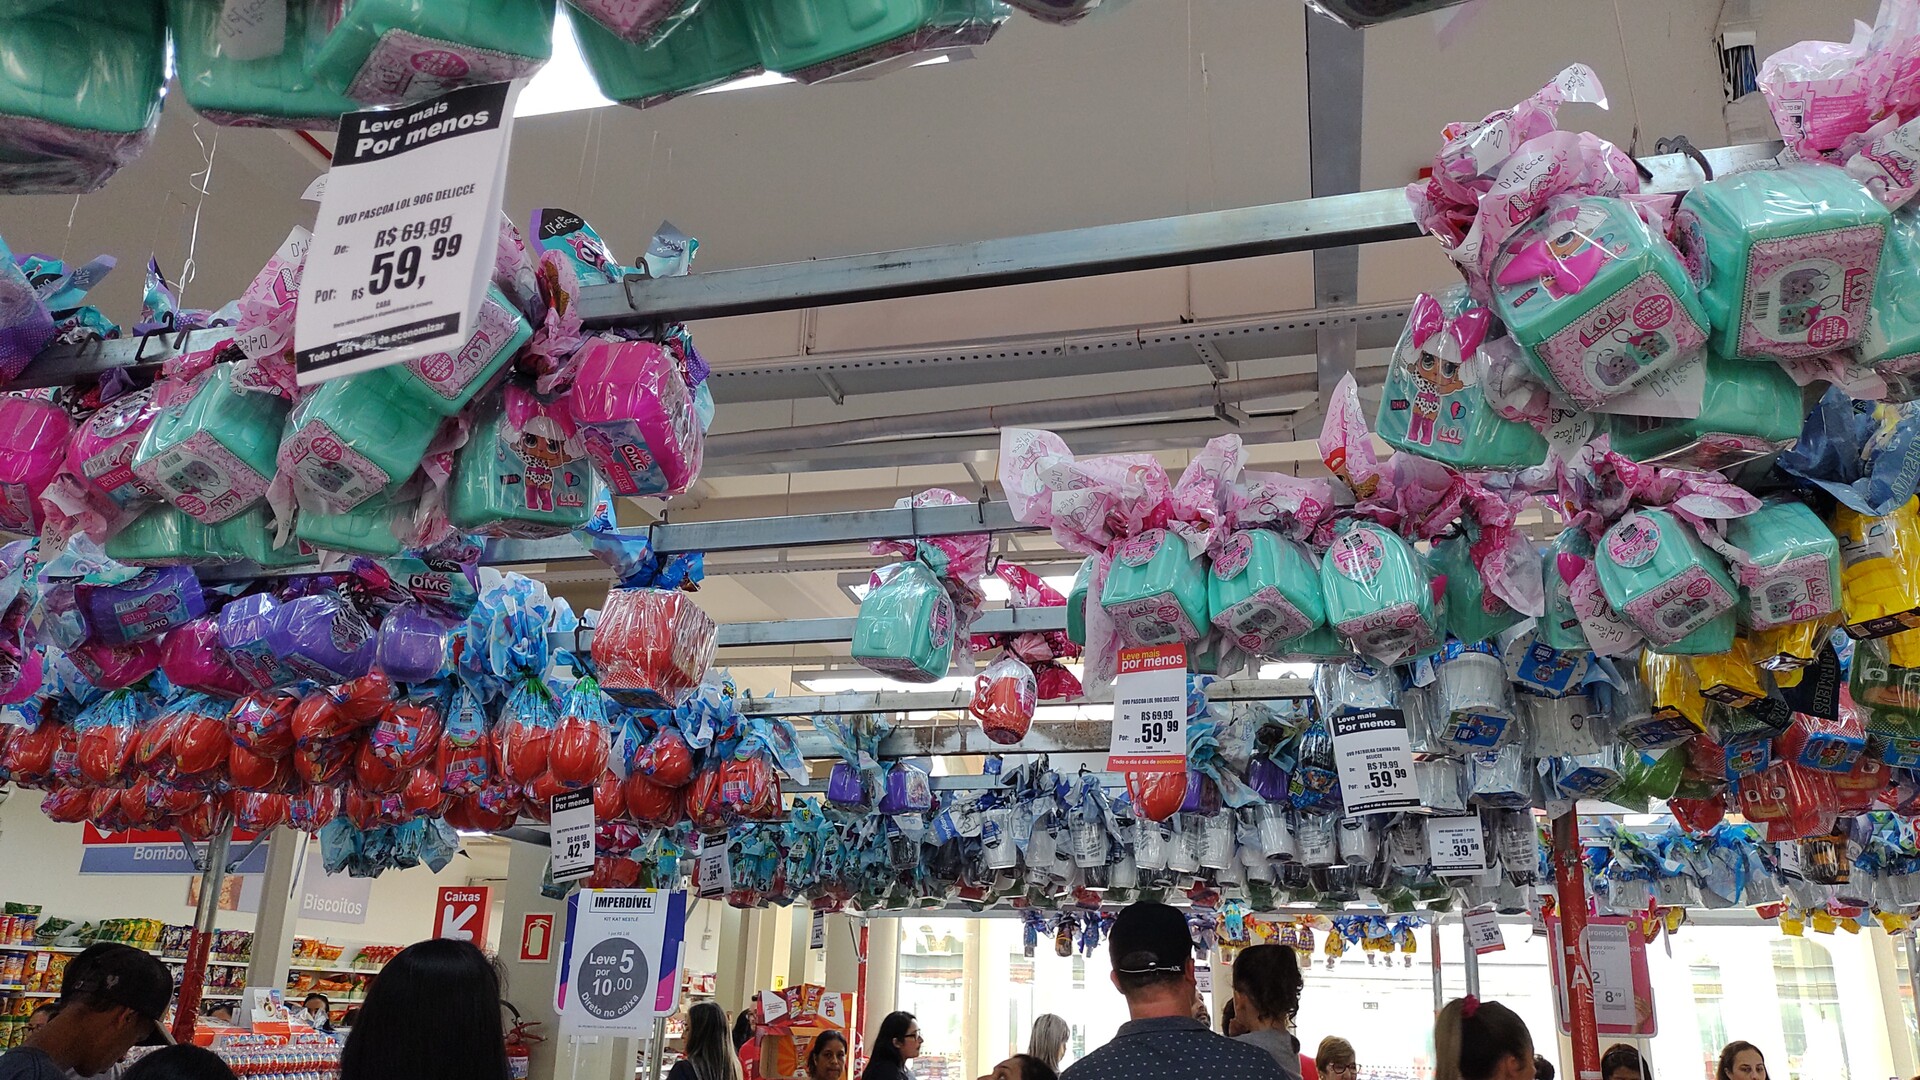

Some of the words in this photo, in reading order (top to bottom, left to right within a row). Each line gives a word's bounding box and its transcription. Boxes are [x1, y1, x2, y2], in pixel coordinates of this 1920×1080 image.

[358, 119, 404, 135] Leve
[408, 101, 449, 125] mais
[354, 134, 401, 158] Por
[405, 110, 489, 146] menos
[1499, 153, 1545, 191] D'elicce
[337, 211, 358, 226] OVO
[358, 203, 394, 222] PASCOA
[396, 197, 411, 212] LOL
[412, 192, 434, 207] 90G
[435, 183, 476, 202] DELICCE
[333, 244, 350, 256] De:
[374, 226, 398, 249] R$
[400, 215, 453, 243] 69,99
[314, 287, 337, 304] Por:
[351, 287, 364, 301] R$
[308, 350, 331, 364] Todo
[331, 348, 338, 357] o
[378, 335, 390, 345] de
[391, 322, 446, 342] economizar
[1650, 355, 1701, 398] D'elicce
[624, 445, 647, 471] OMG
[411, 576, 452, 592] OMG
[1590, 621, 1624, 643] D'elicce
[1121, 652, 1140, 661] Leve
[1141, 649, 1160, 659] mais
[1121, 659, 1141, 672] por
[1143, 654, 1183, 668] menos
[1141, 712, 1151, 721] R$
[1337, 715, 1356, 723] Leve
[1357, 712, 1377, 720] mais
[1338, 723, 1357, 733] Por
[1360, 719, 1397, 729] menos
[1367, 762, 1378, 771] R$
[555, 803, 567, 811] Por
[568, 797, 590, 808] menos
[303, 893, 363, 916] Biscoitos
[444, 891, 481, 902] Caixas
[594, 895, 652, 909] IMPERDÍVEL
[589, 953, 617, 965] Leve
[619, 949, 634, 974] 5
[595, 968, 610, 978] por
[592, 977, 633, 996] 10,00
[581, 991, 602, 1015] Direto
[603, 1009, 615, 1017] no
[617, 994, 639, 1015] caixa
